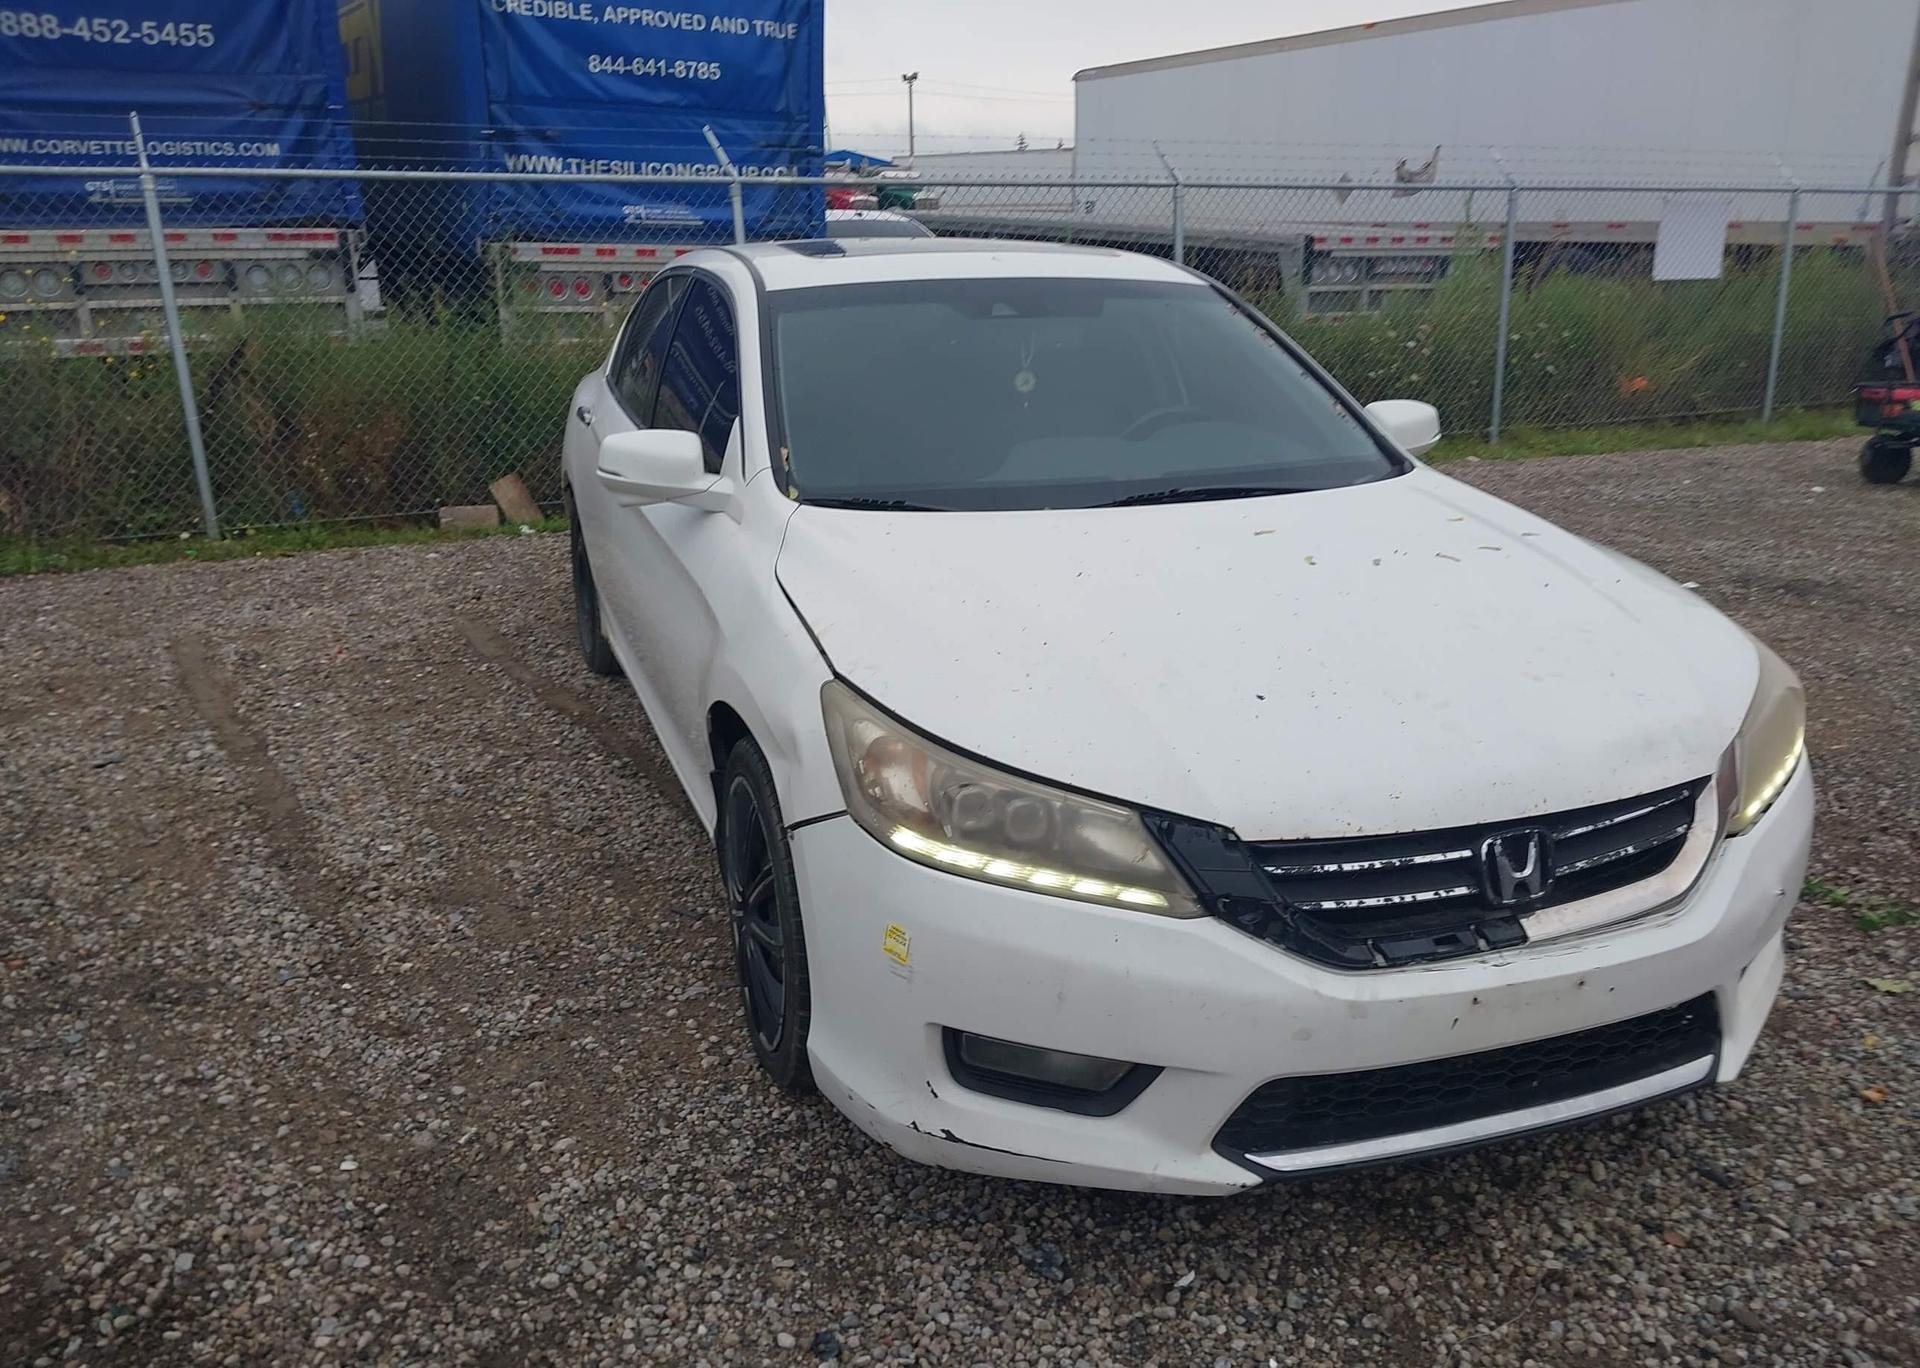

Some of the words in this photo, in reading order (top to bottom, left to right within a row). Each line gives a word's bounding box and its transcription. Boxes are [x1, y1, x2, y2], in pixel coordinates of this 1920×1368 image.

[0, 11, 215, 47] 888-452-5455
[603, 5, 707, 31] APPROVED
[710, 15, 750, 35] AND
[752, 19, 799, 39] TRUE
[588, 54, 721, 80] 844-641-8785
